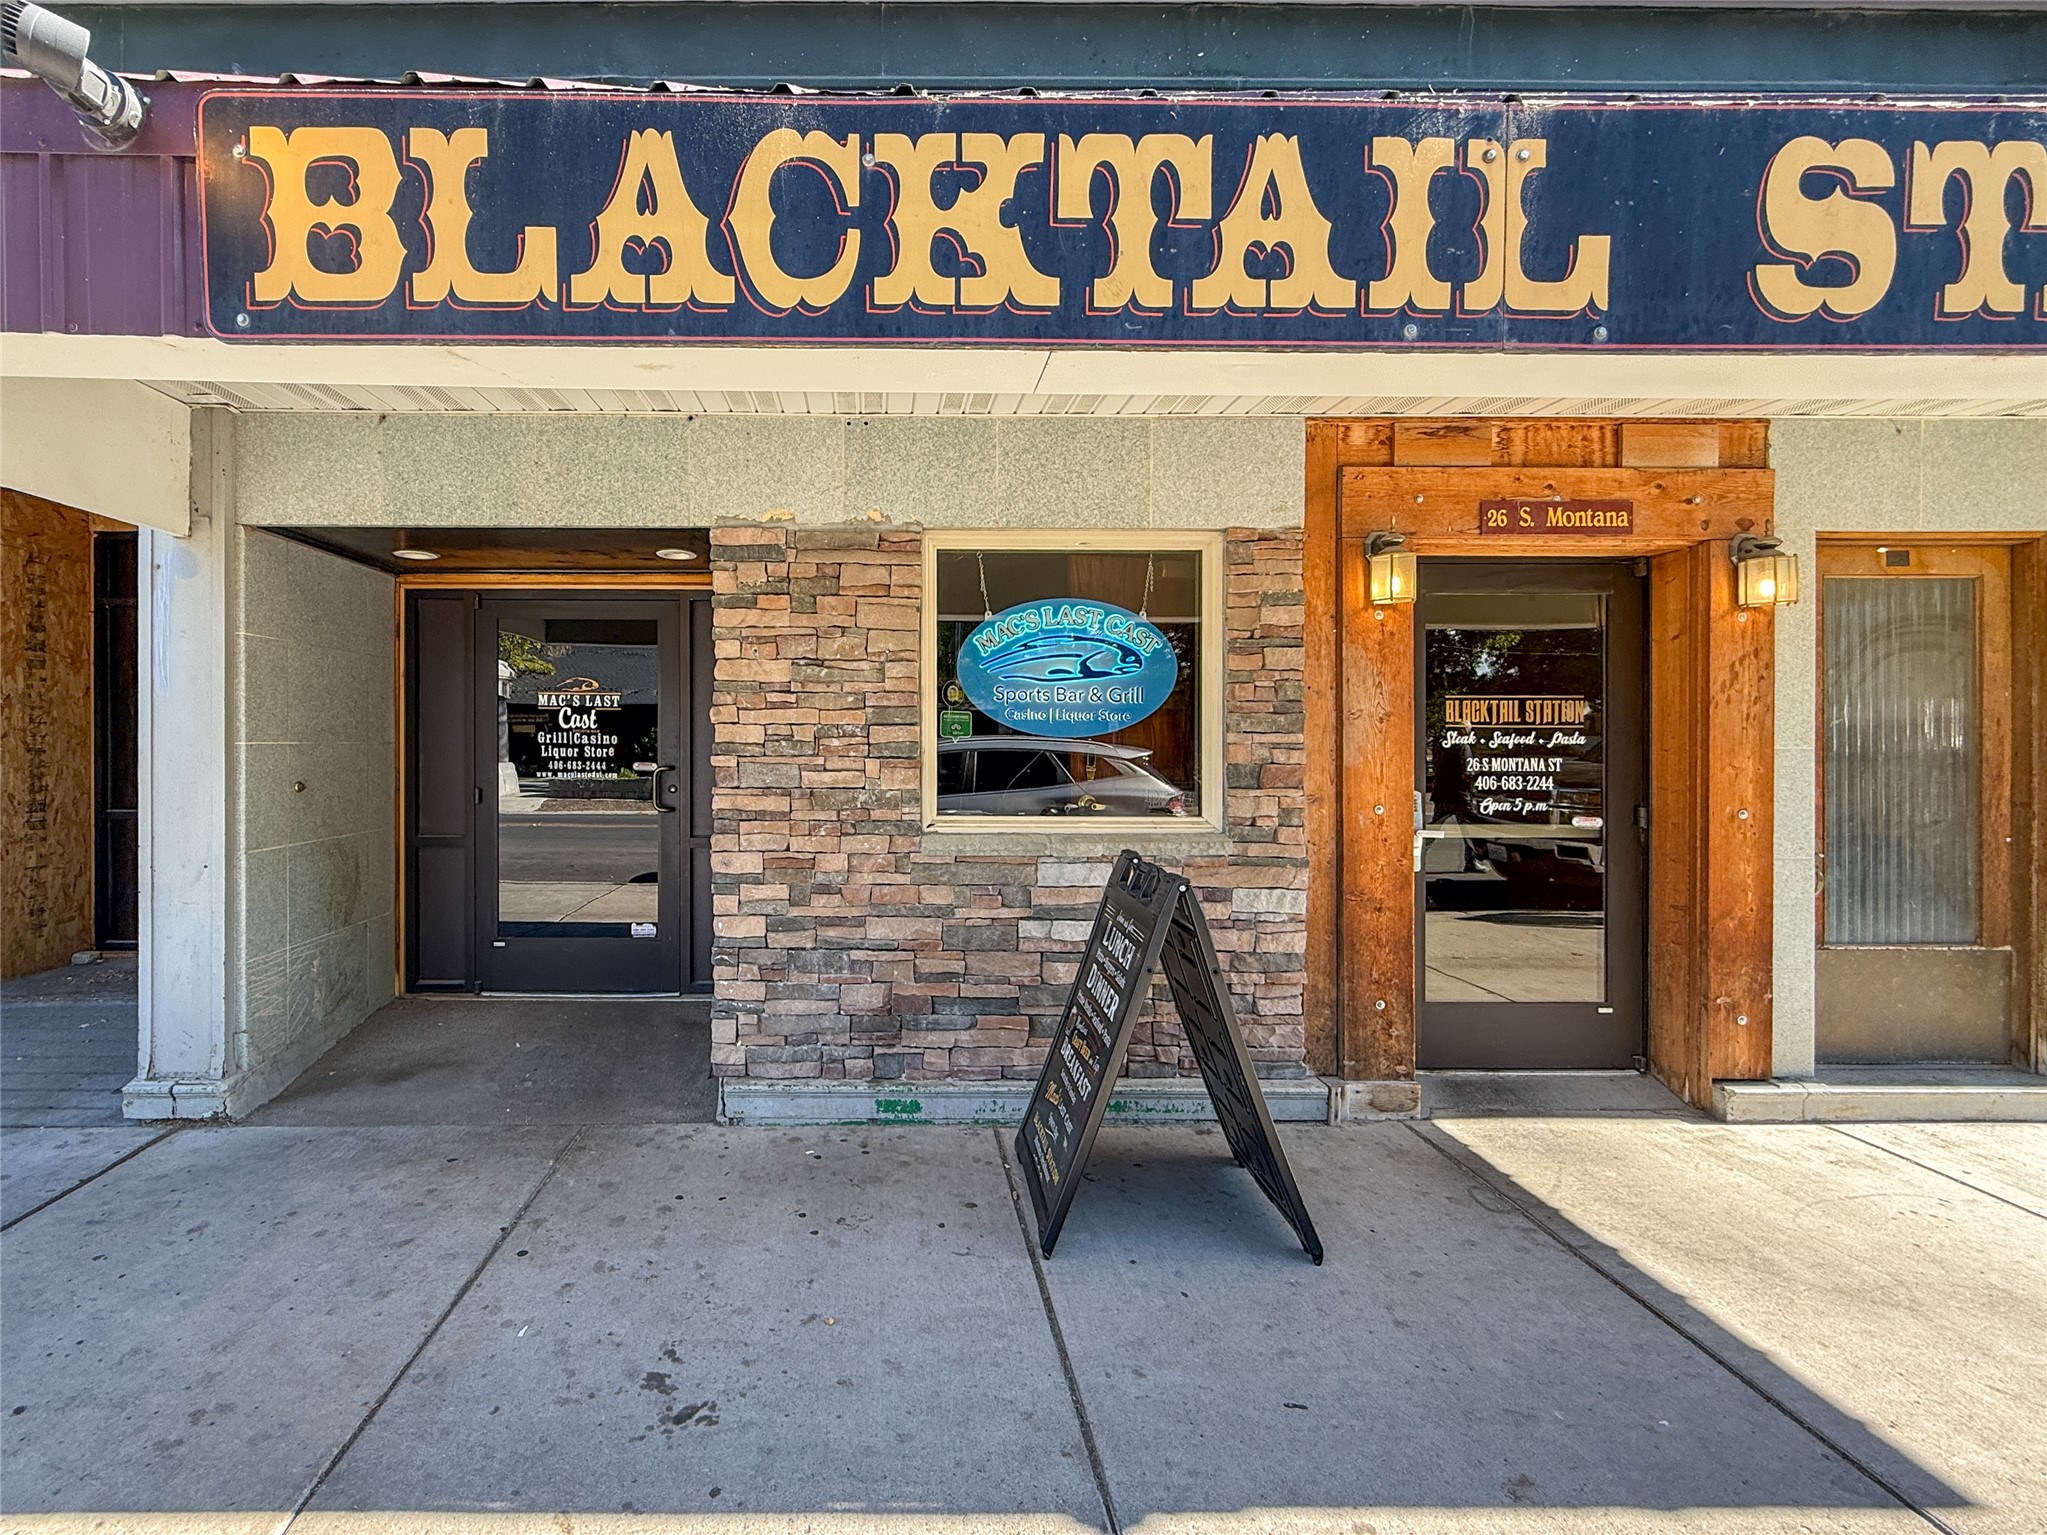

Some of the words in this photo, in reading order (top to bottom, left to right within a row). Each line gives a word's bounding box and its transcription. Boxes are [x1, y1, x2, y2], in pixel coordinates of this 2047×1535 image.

[246, 126, 1610, 315] BLACKTAIL
[1752, 136, 2047, 318] ST
[1487, 509, 1507, 527] 26
[1519, 507, 1534, 527] S.
[1546, 507, 1629, 527] Montana
[975, 610, 1041, 655] MAC'S
[1042, 605, 1103, 630] LAST
[1106, 616, 1162, 656] CAST
[537, 694, 580, 707] MAC'S
[585, 695, 620, 708] LAST
[993, 686, 1050, 706] Sports
[1055, 687, 1084, 703] Bar
[1089, 686, 1102, 703] &
[1107, 687, 1145, 704] Grill
[558, 706, 598, 729] Cast
[1004, 708, 1046, 721] Casino
[1056, 708, 1096, 723] Liquor
[1098, 709, 1132, 722] Store
[1445, 700, 1521, 724] BLACKTAIL
[1526, 700, 1585, 725] STATION
[1441, 731, 1477, 748] Steak
[1489, 731, 1537, 749] Seafood
[1546, 731, 1587, 748] Pasta
[541, 745, 579, 759] Liquor
[584, 746, 615, 758] Store
[548, 761, 606, 770] 406-683-2444
[1466, 757, 1480, 772] 26
[1482, 758, 1489, 772] S
[1491, 757, 1546, 772] MONTANA
[1548, 757, 1563, 772] ST
[1475, 776, 1554, 790] 406-683-2244
[1479, 798, 1513, 814] Open
[1513, 798, 1522, 811] 5
[1102, 920, 1136, 970] LUNCH
[1086, 962, 1121, 1023] DINNER
[1060, 1035, 1092, 1102] BREAKFAST
